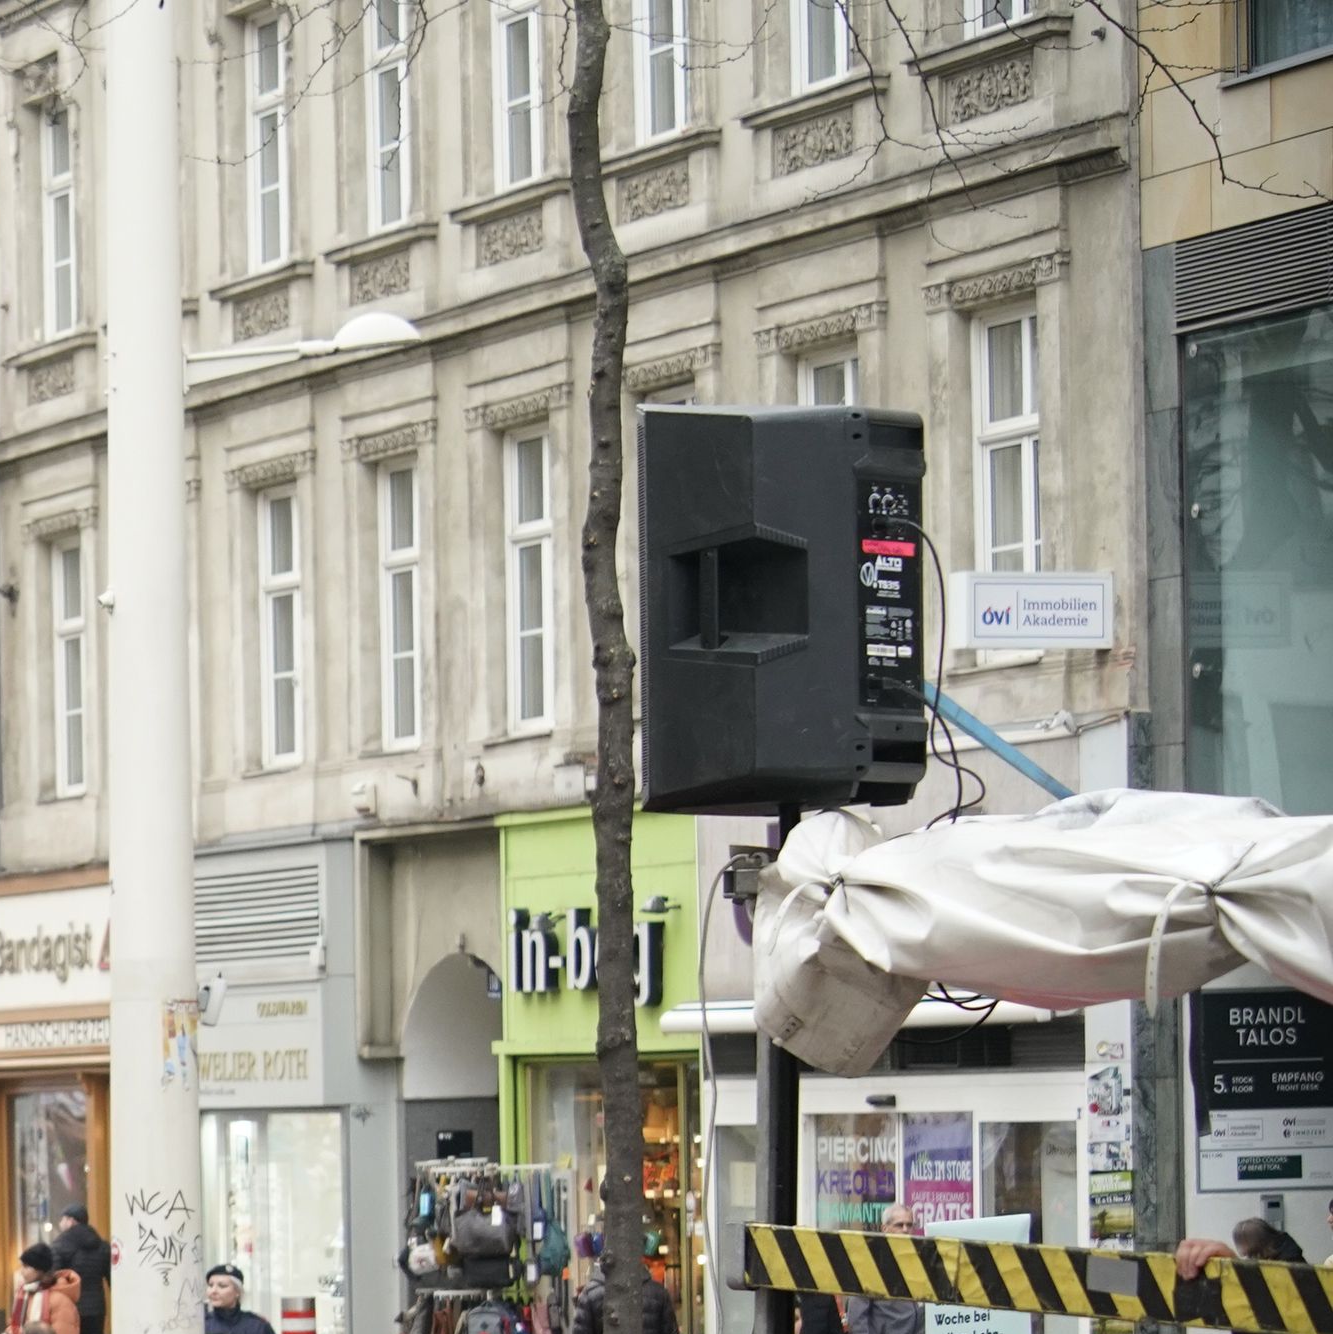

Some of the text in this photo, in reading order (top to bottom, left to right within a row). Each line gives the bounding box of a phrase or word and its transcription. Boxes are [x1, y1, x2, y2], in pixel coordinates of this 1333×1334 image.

[876, 555, 903, 568] ALTO
[1023, 598, 1097, 612] Immobilien
[1023, 614, 1088, 627] Akademie
[1229, 1007, 1306, 1026] BRANDL
[1236, 1028, 1297, 1045] TALOS
[263, 1048, 309, 1080] ROTH
[1213, 1074, 1228, 1094] 5.
[1232, 1076, 1253, 1084] STOCK
[1272, 1071, 1324, 1083] EMPFANG
[1232, 1085, 1253, 1093] FLOOR
[1300, 1083, 1319, 1091] DESK
[817, 1135, 897, 1163] PIERCING
[910, 1159, 972, 1181] ALLES IM STORE
[912, 1202, 972, 1226] GRATIS
[934, 1308, 991, 1326] Woche bei
